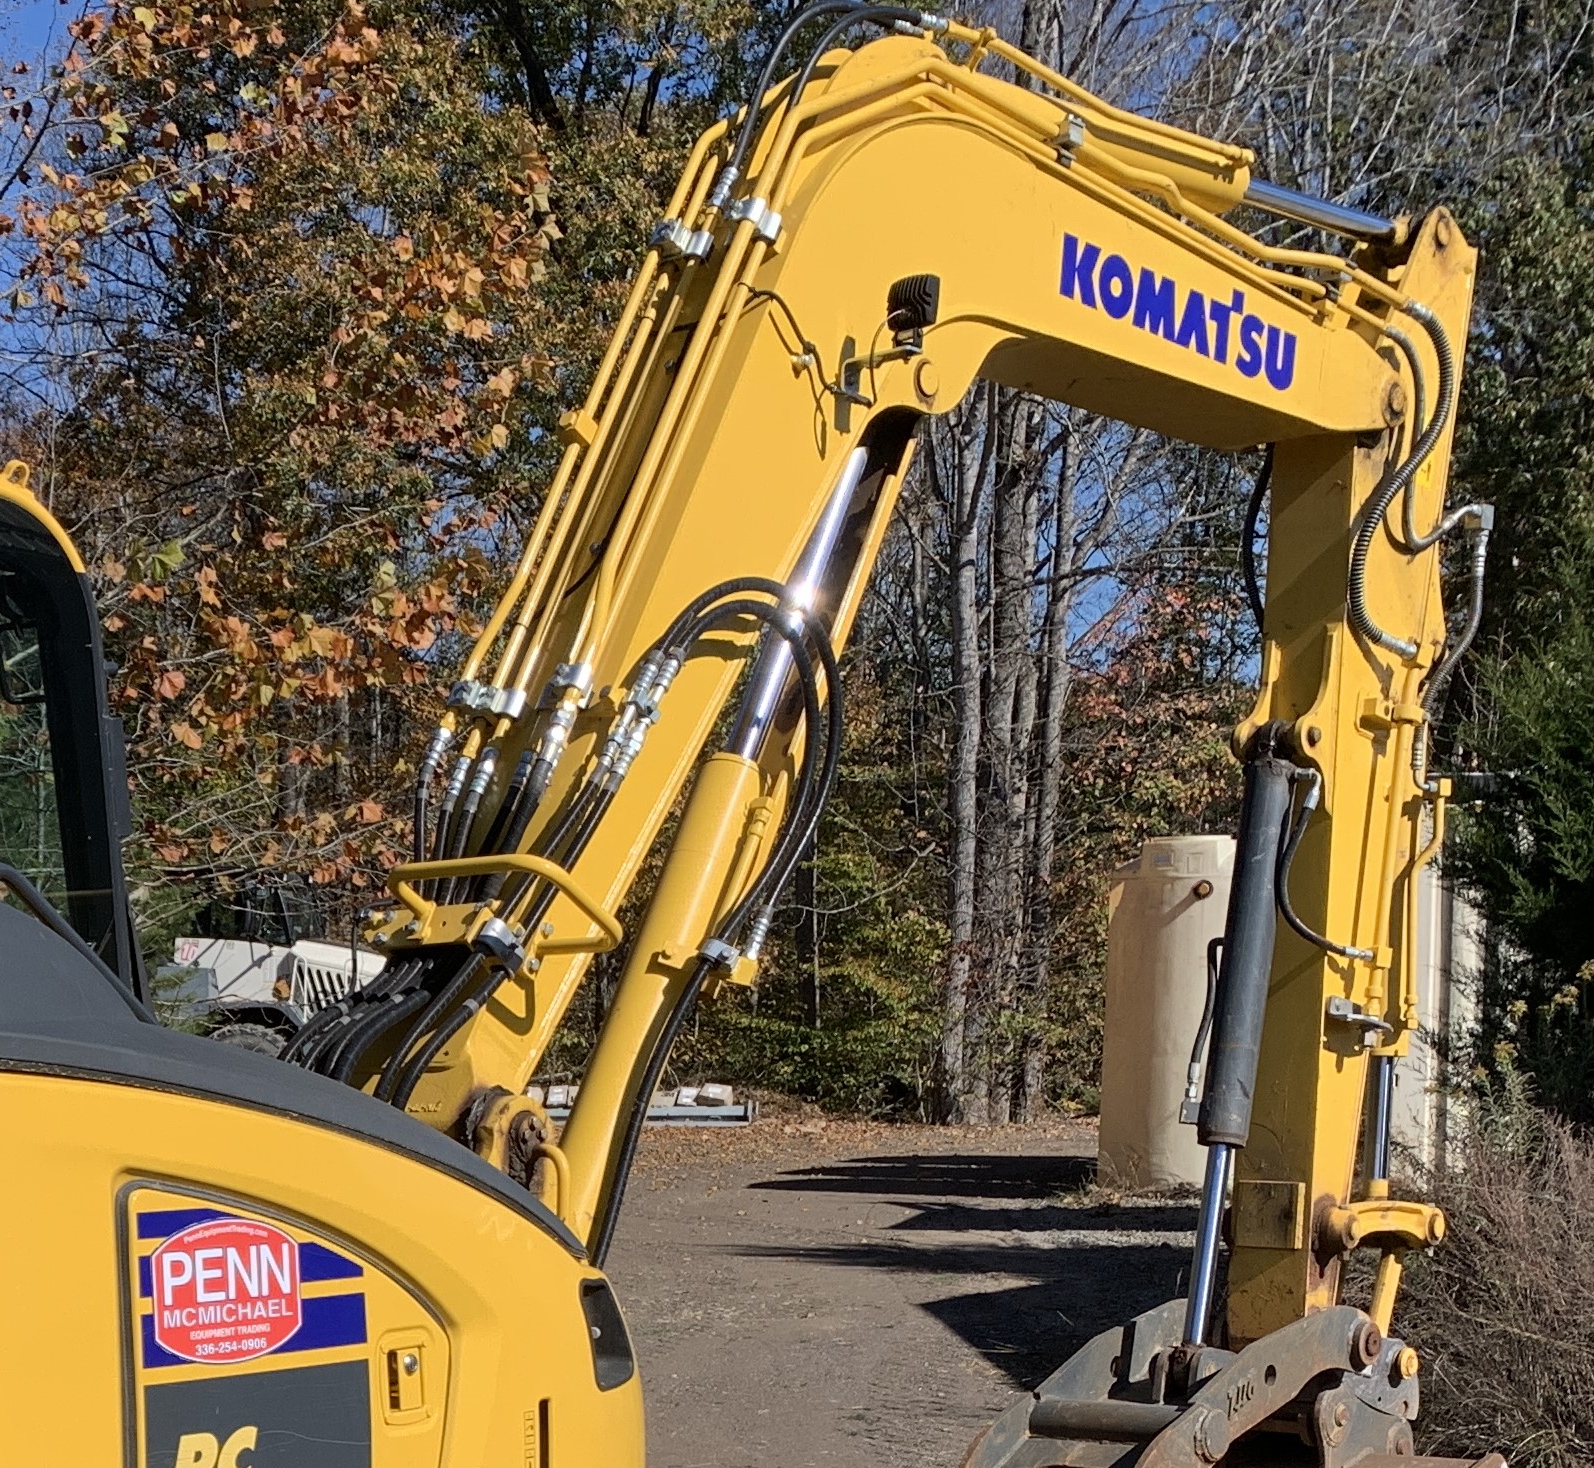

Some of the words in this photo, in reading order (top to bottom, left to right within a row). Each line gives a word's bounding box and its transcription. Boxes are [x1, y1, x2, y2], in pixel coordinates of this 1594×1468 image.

[162, 1242, 292, 1306] PENN
[163, 1299, 294, 1329] MCMICHAEL
[190, 1326, 236, 1341] EQUIPMENT
[237, 1323, 271, 1336] TRADING
[195, 1337, 268, 1356] 336-254-0906
